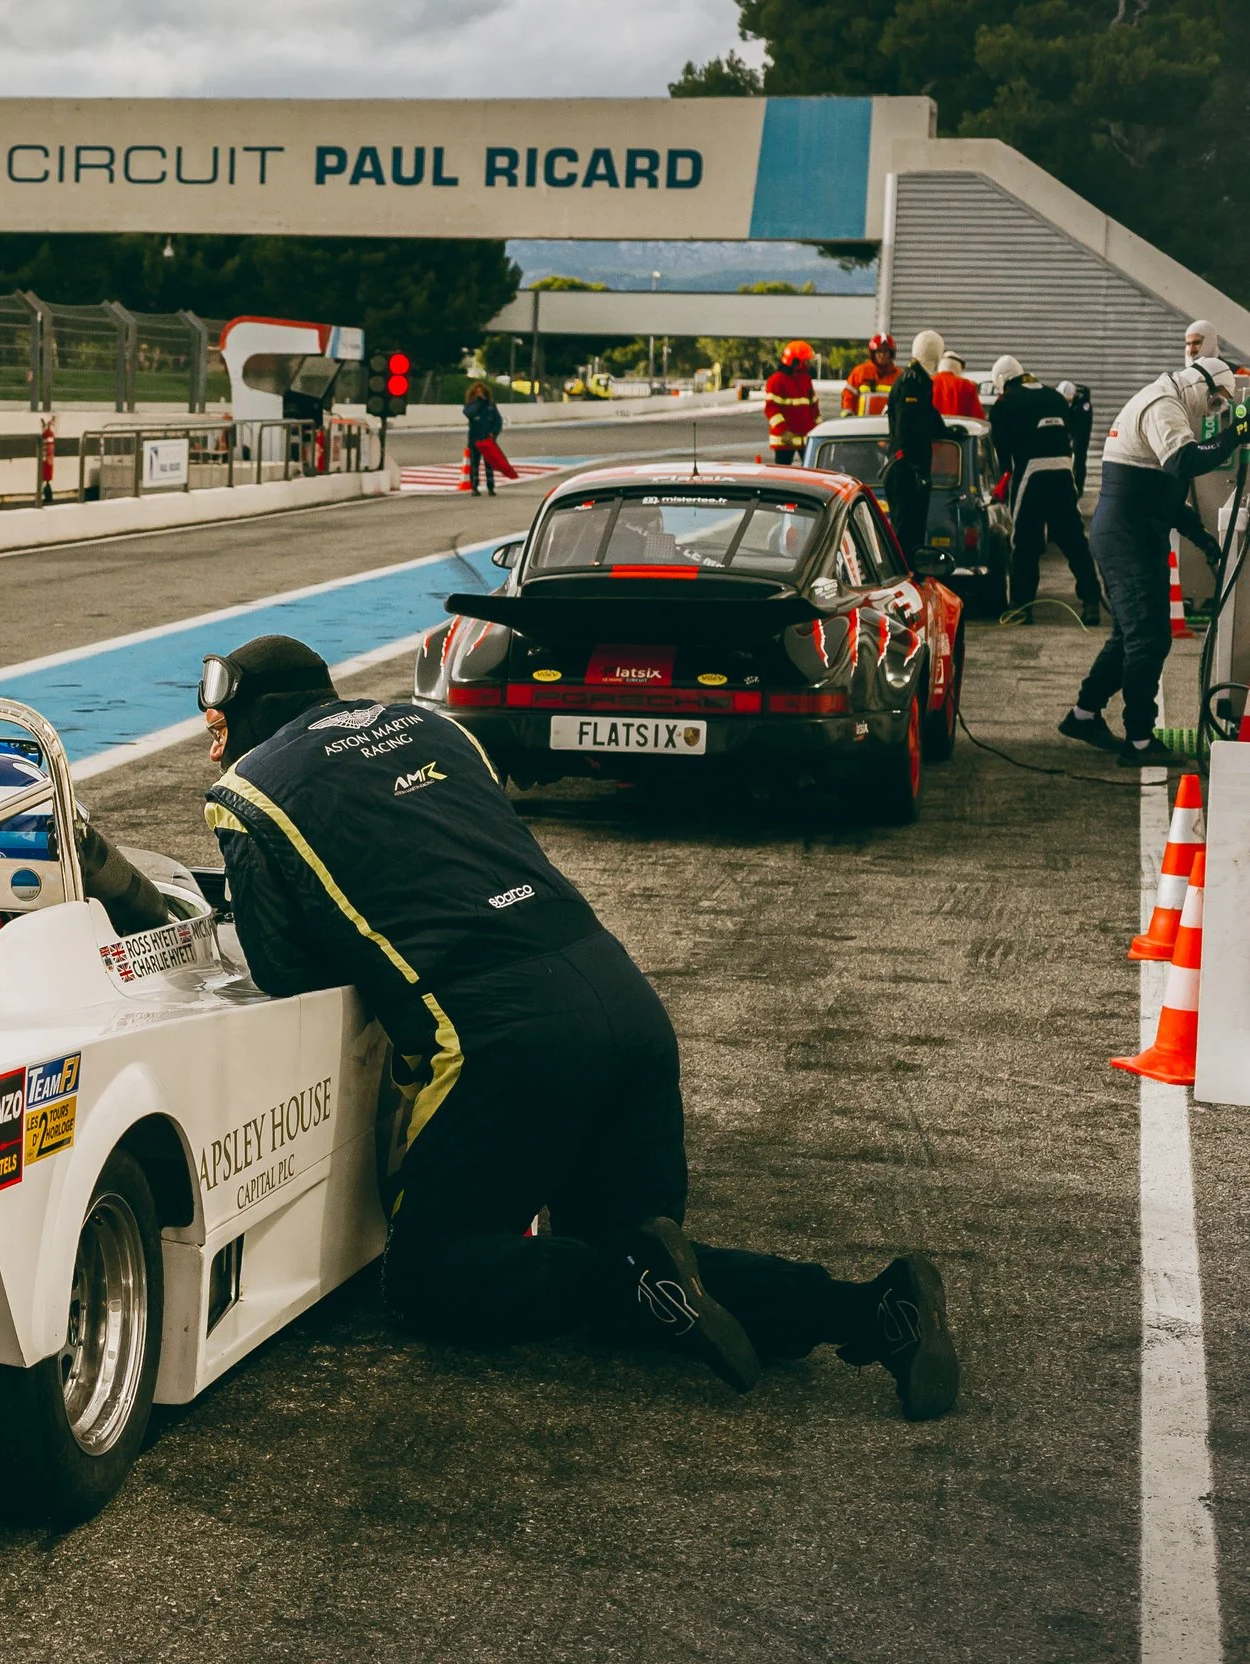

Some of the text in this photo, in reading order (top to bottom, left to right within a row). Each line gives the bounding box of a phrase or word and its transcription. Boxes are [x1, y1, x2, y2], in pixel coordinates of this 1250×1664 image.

[7, 144, 704, 190] CIRCUIT PAUL RICARD
[324, 714, 424, 756] ASTON MARTIN
[361, 733, 413, 758] RACING
[578, 721, 678, 749] FLATSIX
[394, 761, 448, 791] AMR
[488, 884, 535, 908] sparco
[125, 934, 151, 958] ROSS
[150, 926, 179, 951] HYETT
[133, 943, 195, 978] CHARLIE HYETT
[26, 1104, 72, 1157] LES 2 TOURS
[45, 1118, 75, 1141] HORLOGE
[200, 1076, 332, 1191] APSLEY HOUSE
[236, 1153, 295, 1209] CAPITAL PLC
